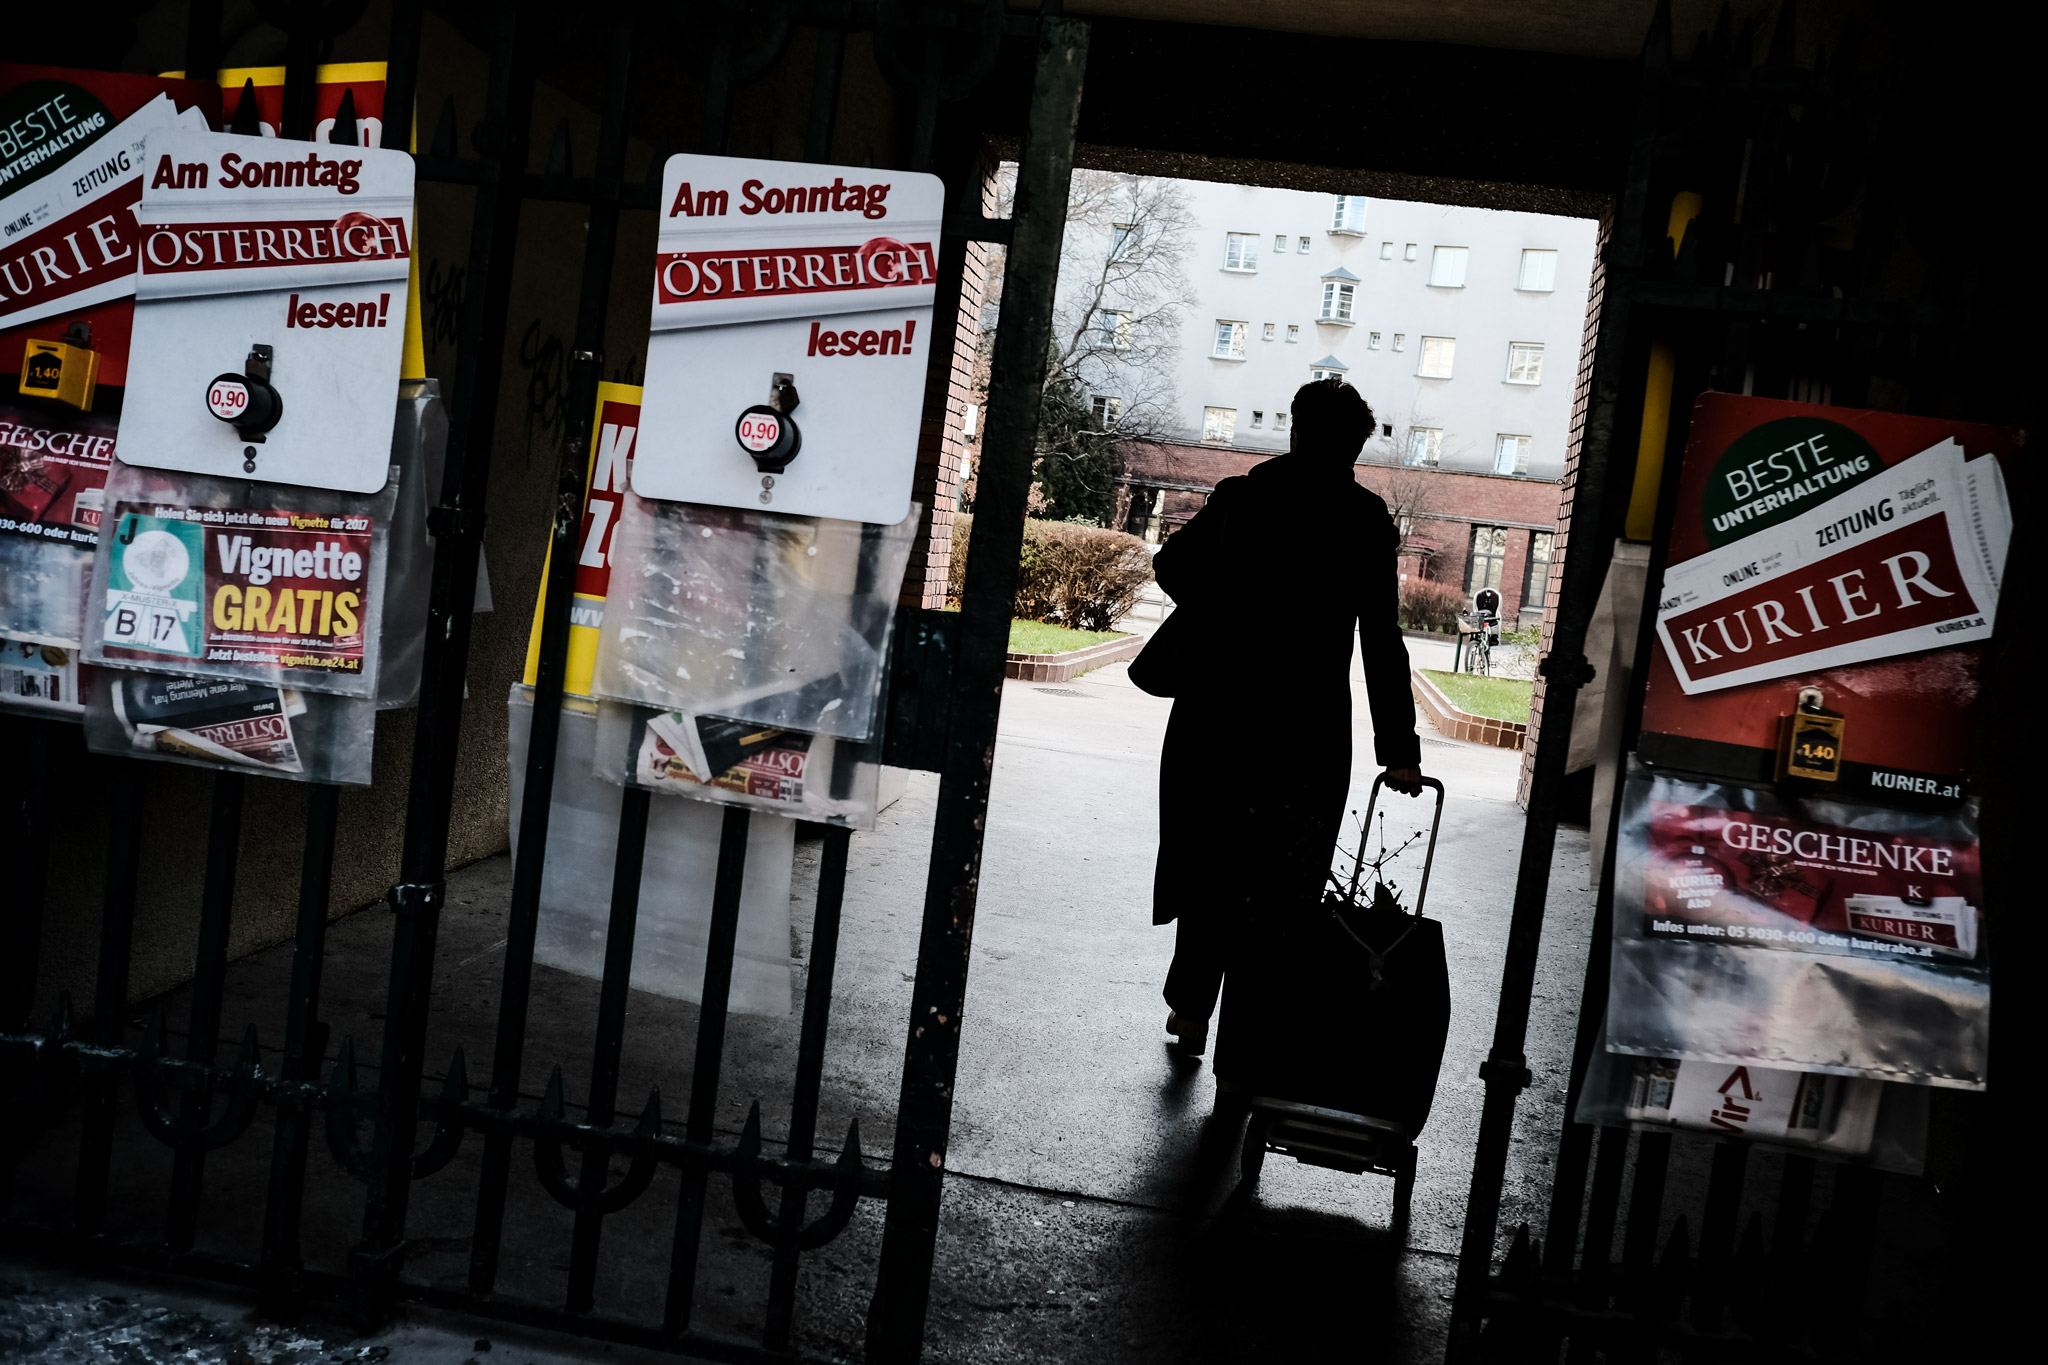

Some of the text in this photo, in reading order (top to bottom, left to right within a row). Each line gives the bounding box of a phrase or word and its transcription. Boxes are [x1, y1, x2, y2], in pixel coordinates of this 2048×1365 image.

[0, 93, 77, 159] BESTE
[151, 152, 362, 195] Am Sonntag
[4, 150, 131, 237] ONLINE ZEITUNG
[670, 178, 890, 219] Am Sonntag
[0, 200, 140, 301] URIE
[146, 224, 406, 268] ÖSTERREICH
[663, 250, 934, 297] ÖSTERREICH
[287, 293, 390, 328] lesen!
[807, 320, 916, 357] lesen!
[211, 389, 246, 409] 0,90
[0, 422, 116, 462] GESCHE
[742, 421, 777, 441] 0,90
[1725, 433, 1835, 502] BESTE
[1712, 455, 1870, 533] UNTERHALTUNG
[1901, 491, 1941, 515] aktuell.
[43, 527, 69, 539] oder
[71, 527, 99, 544] kurie
[120, 518, 138, 545] J
[155, 507, 369, 531] Holen Sie sich jetzt die neue Vignette für 2017
[1723, 562, 1760, 587] ONLINE
[1816, 498, 1894, 548] ZEITUNG
[1898, 478, 1936, 502] Täglich
[217, 534, 362, 586] Vignette
[115, 609, 176, 641] B 17
[1680, 550, 1956, 665] KURIER
[1935, 617, 1986, 635] KURIER.at
[207, 649, 360, 670] Jetzt bestellen: vignette.oe24.at
[169, 687, 208, 702] Meinung
[1871, 771, 1961, 799] KURIER.at
[1721, 821, 1954, 877] GESCHENKE
[1669, 874, 1724, 889] KURIER
[1687, 899, 1712, 909] Abo
[1652, 920, 1933, 958] Infos unter: 05 9030-600 oder kurierabo.at
[1859, 916, 1936, 941] KURIER
